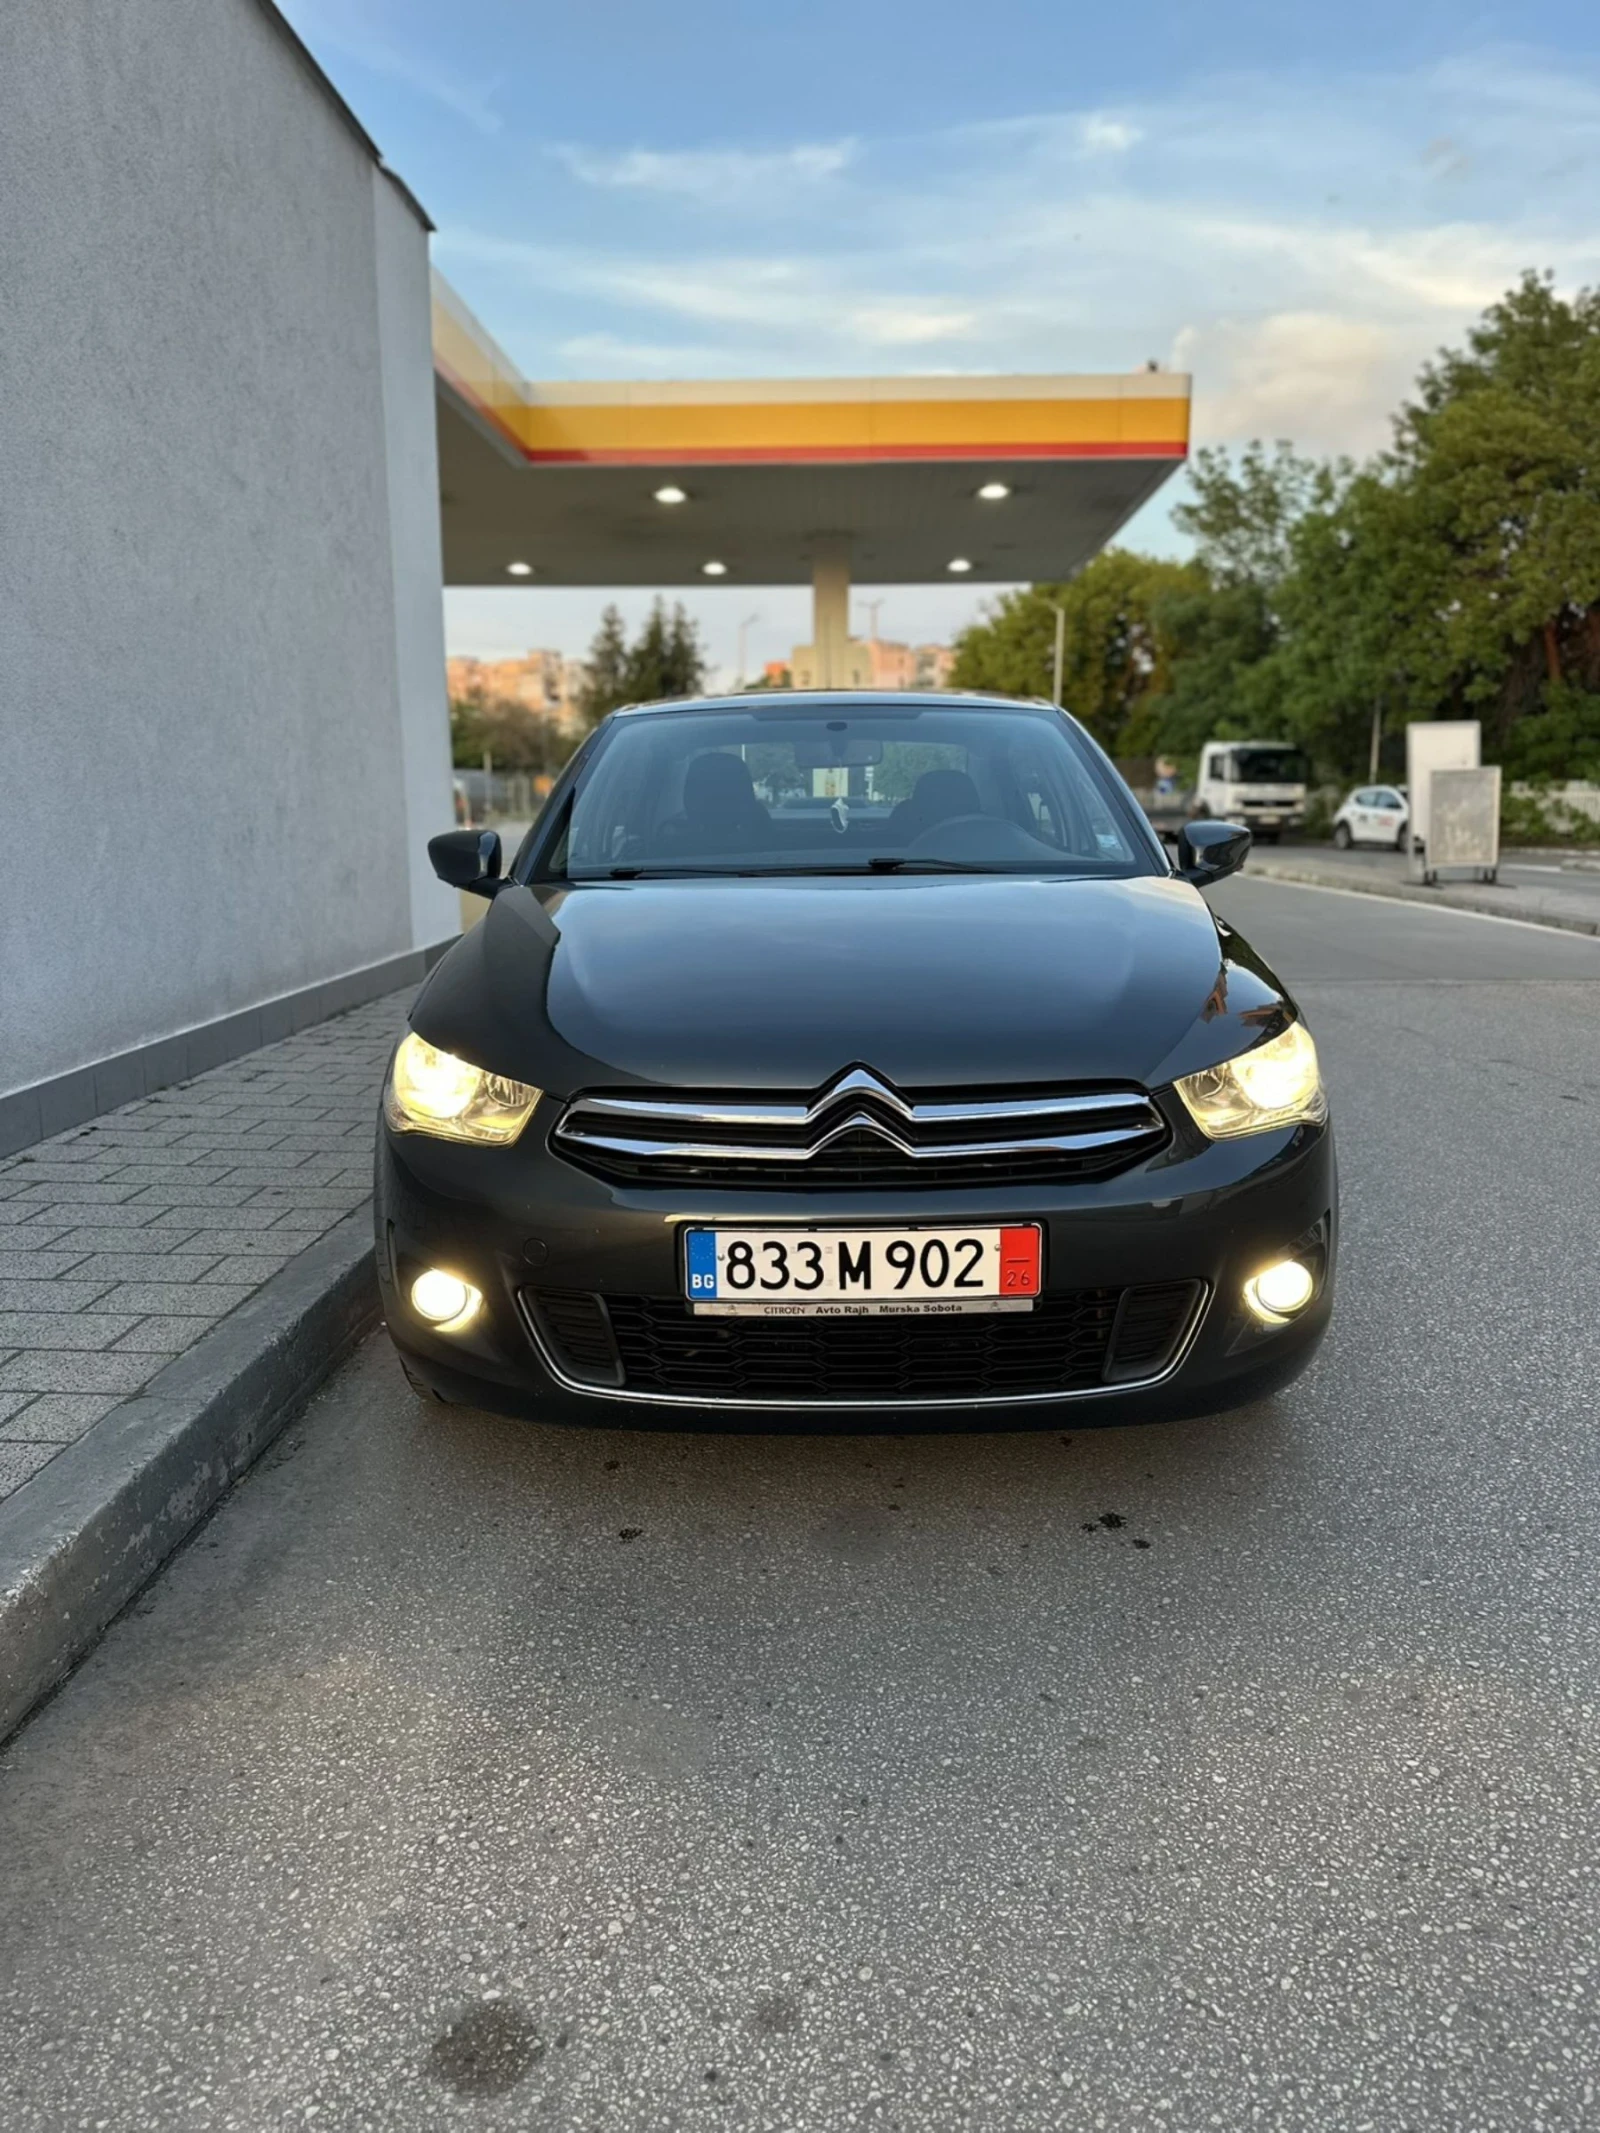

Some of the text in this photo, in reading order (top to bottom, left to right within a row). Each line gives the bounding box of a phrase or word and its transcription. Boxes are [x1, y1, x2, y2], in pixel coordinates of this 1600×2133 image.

[725, 1238, 984, 1290] 833 M 902
[692, 1274, 715, 1289] BG
[1006, 1269, 1031, 1287] 26
[815, 1306, 841, 1315] Avto
[844, 1305, 869, 1316] Rajh
[879, 1305, 920, 1314] Murska
[923, 1304, 962, 1313] Sobota
